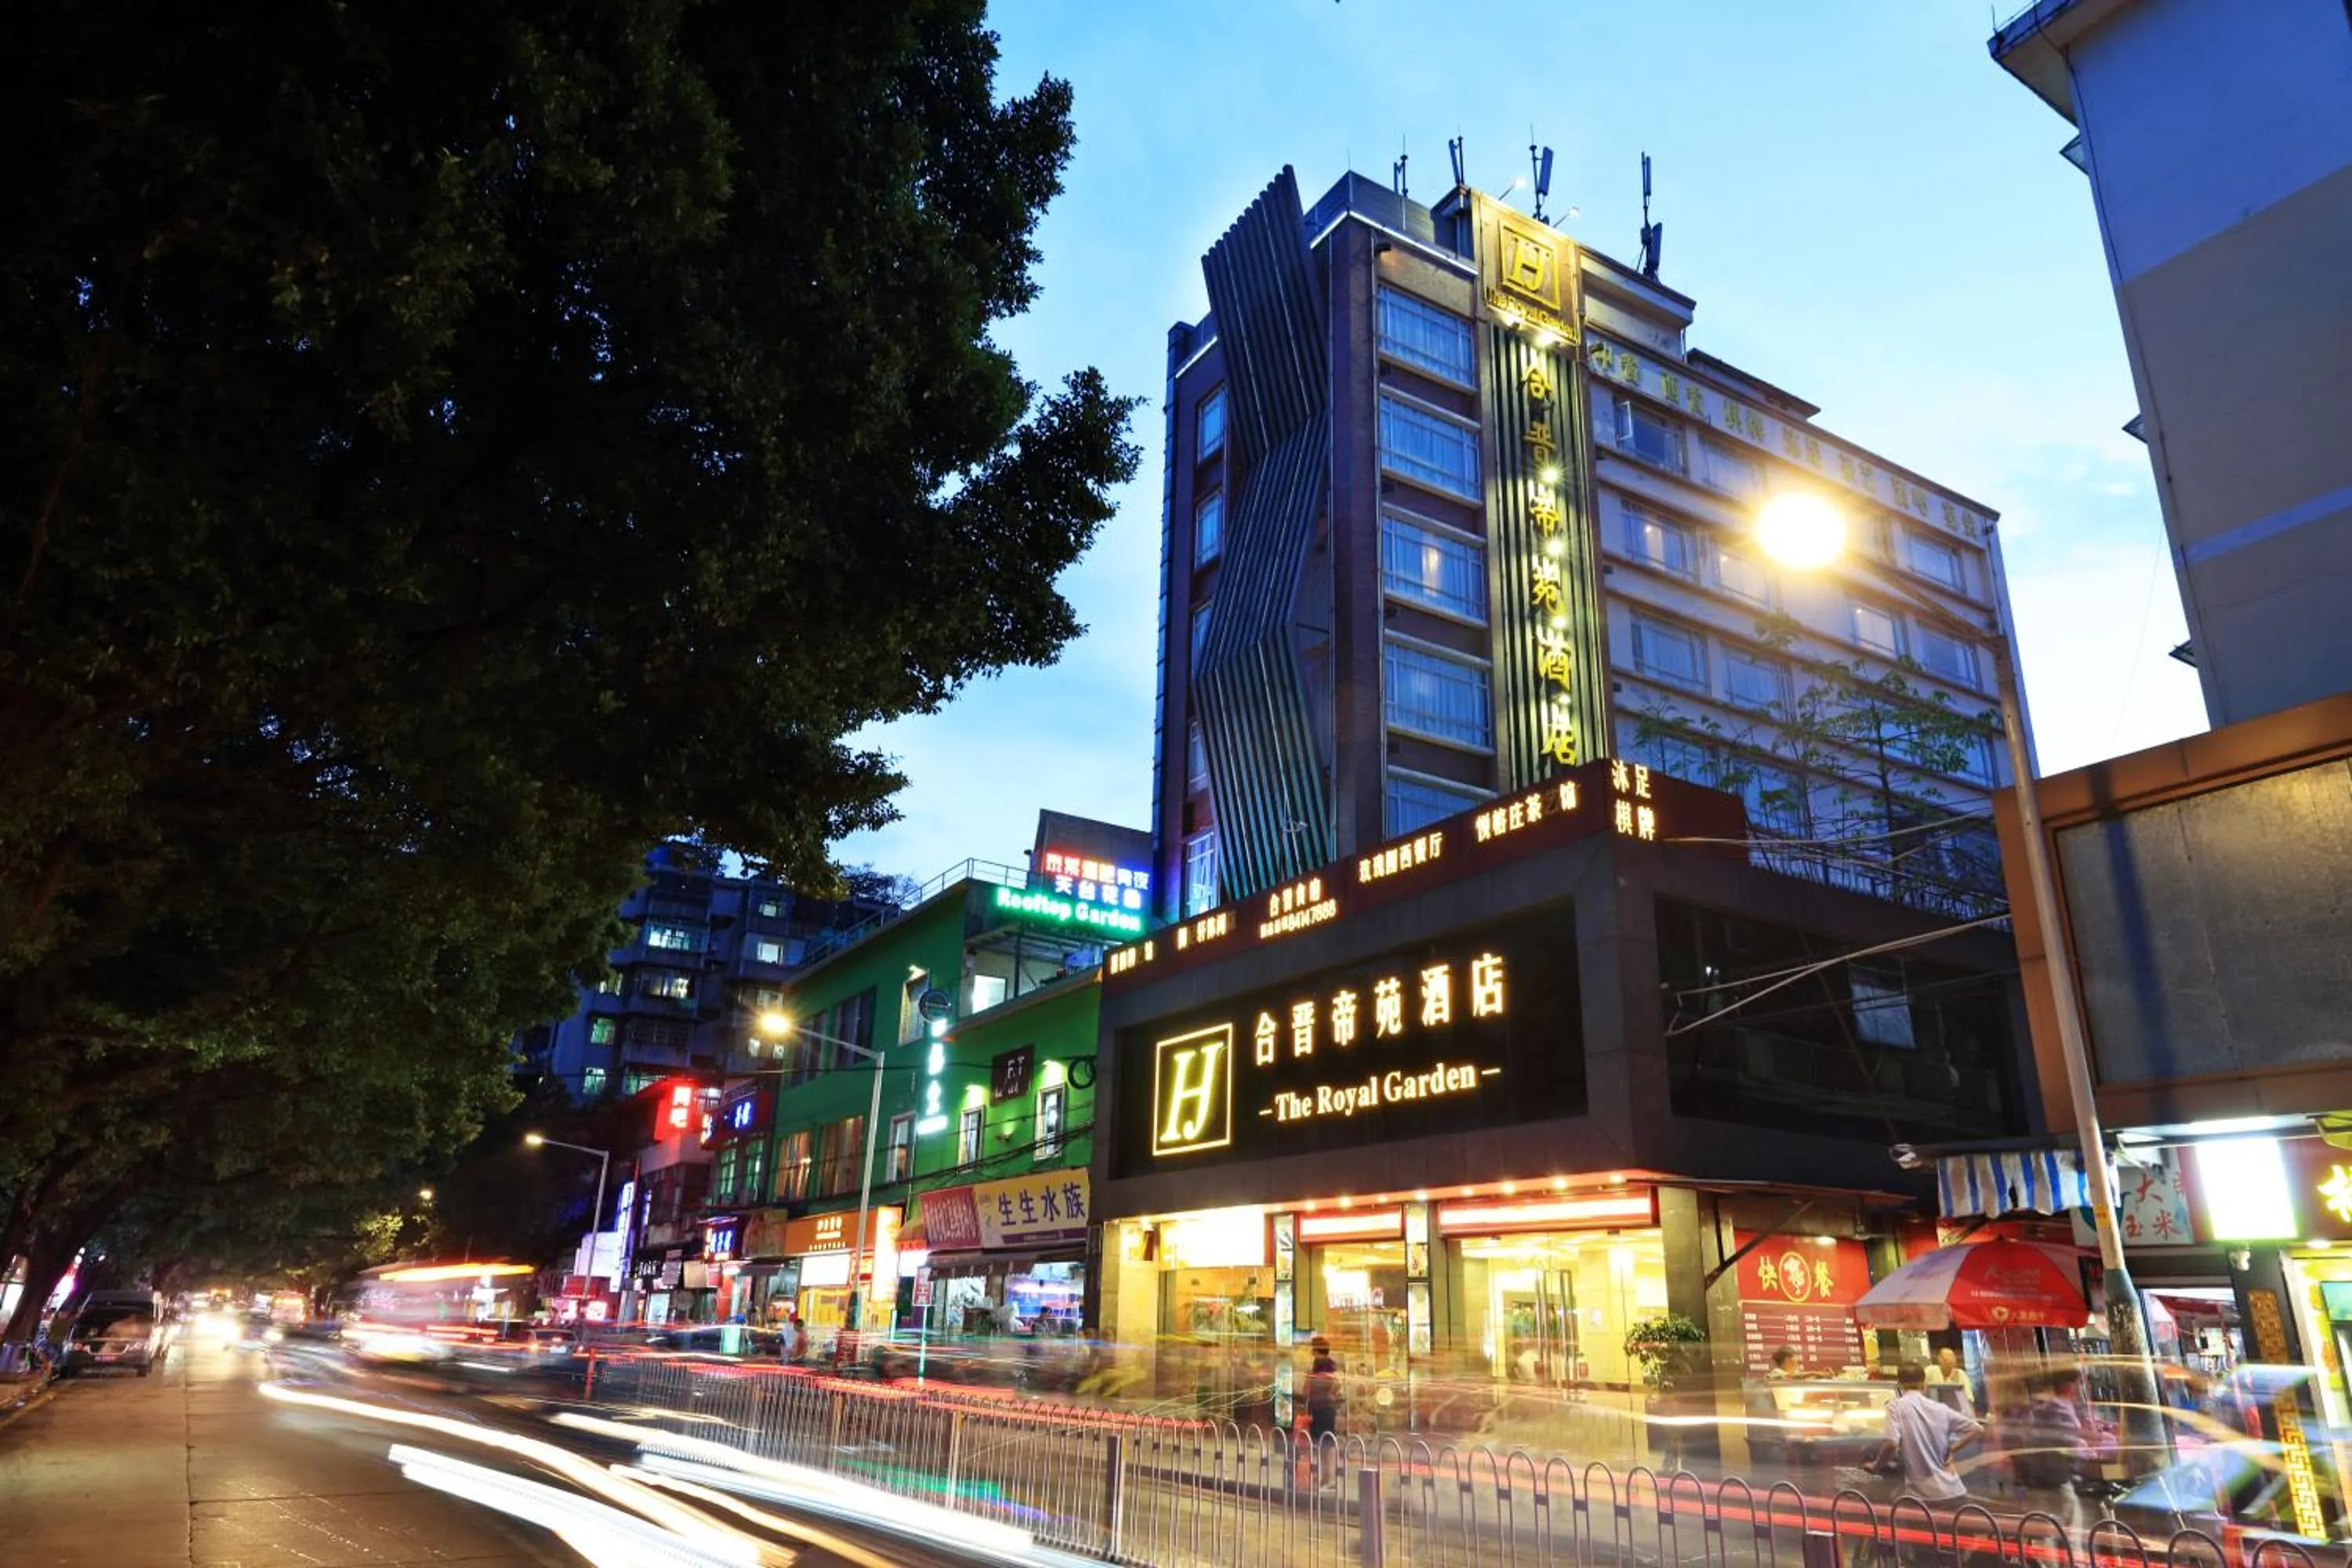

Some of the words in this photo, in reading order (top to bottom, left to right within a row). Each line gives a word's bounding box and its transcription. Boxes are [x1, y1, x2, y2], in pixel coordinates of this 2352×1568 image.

[1615, 798, 1657, 841] 棋牌
[996, 887, 1071, 920] Rooftop
[1075, 902, 1142, 932] Garden
[1254, 952, 1504, 1066] 合晋帝苑酒店
[1274, 1091, 1312, 1122] The
[1316, 1075, 1379, 1117] Royal
[1383, 1062, 1477, 1103] Garden
[998, 1181, 1086, 1228] 生生水族
